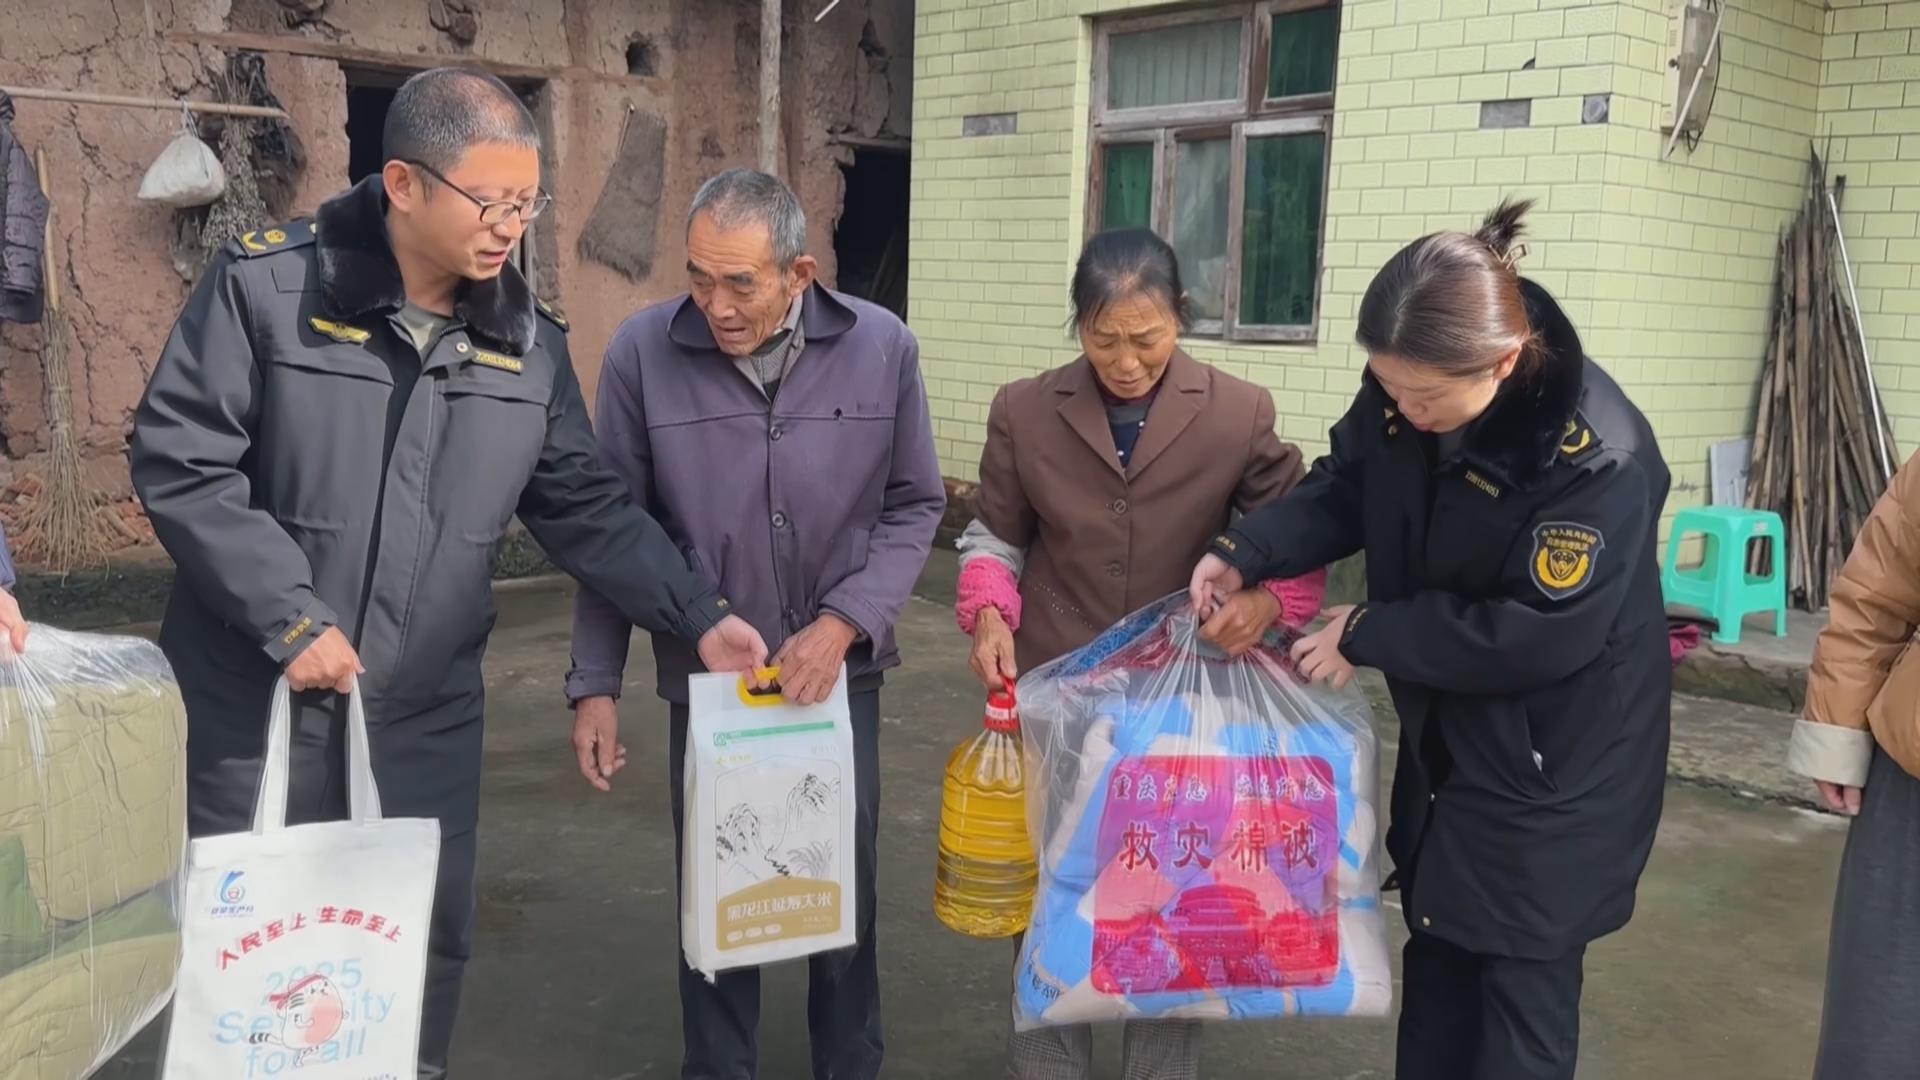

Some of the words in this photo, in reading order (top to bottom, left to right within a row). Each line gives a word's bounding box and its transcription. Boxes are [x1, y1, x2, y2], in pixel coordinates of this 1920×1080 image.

[1119, 820, 1320, 873] 救灾棉被
[216, 912, 307, 971] 人民至上
[317, 905, 402, 944] 生命至上
[214, 988, 397, 1045] Seity
[321, 1026, 368, 1064] all
